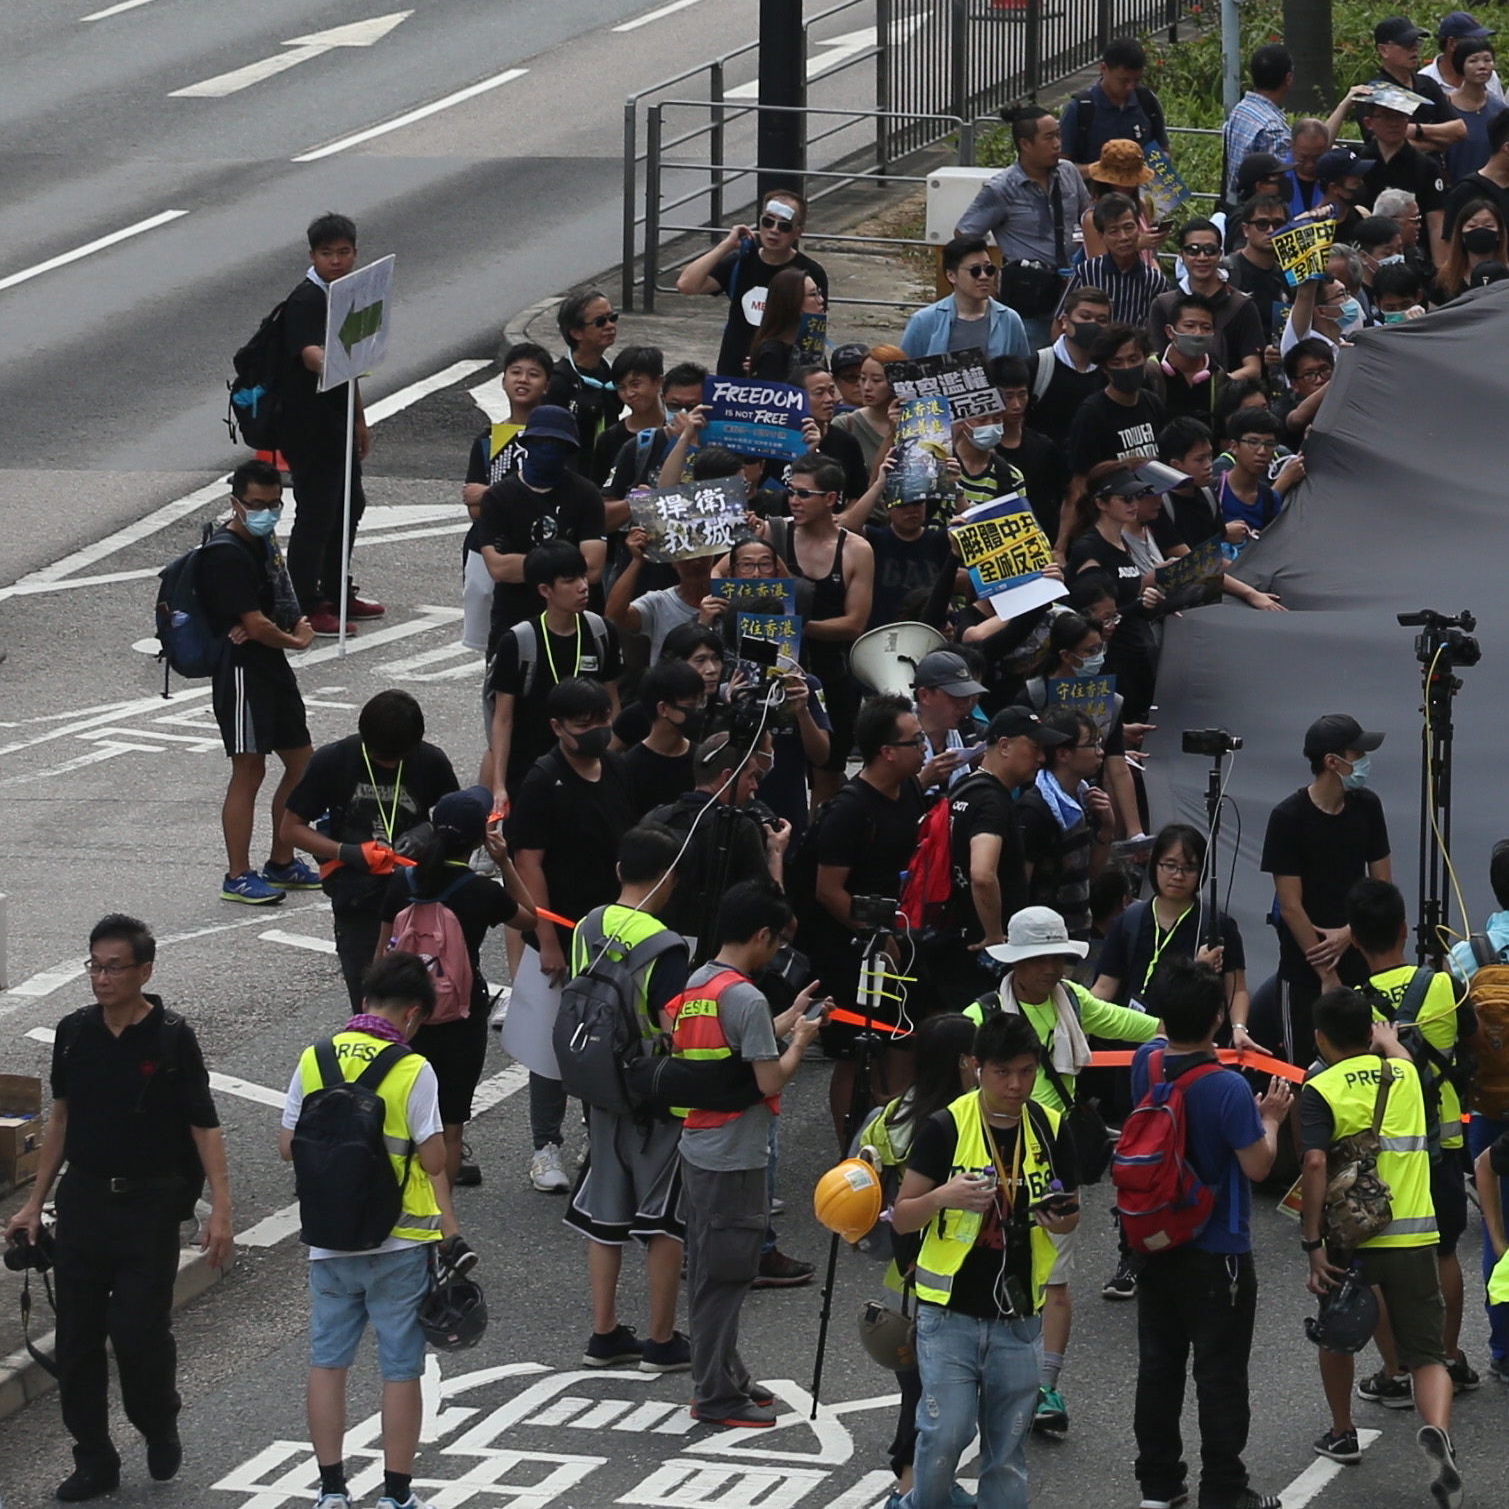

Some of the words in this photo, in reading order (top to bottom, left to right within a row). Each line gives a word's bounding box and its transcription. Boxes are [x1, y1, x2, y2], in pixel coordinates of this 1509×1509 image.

[712, 381, 804, 412] FREEDOM
[725, 408, 734, 419] IS
[734, 409, 754, 421] NOT
[753, 409, 790, 428] FREE
[664, 516, 737, 555] 我城
[721, 582, 791, 600] 守住香港
[1344, 1066, 1405, 1089] PRES
